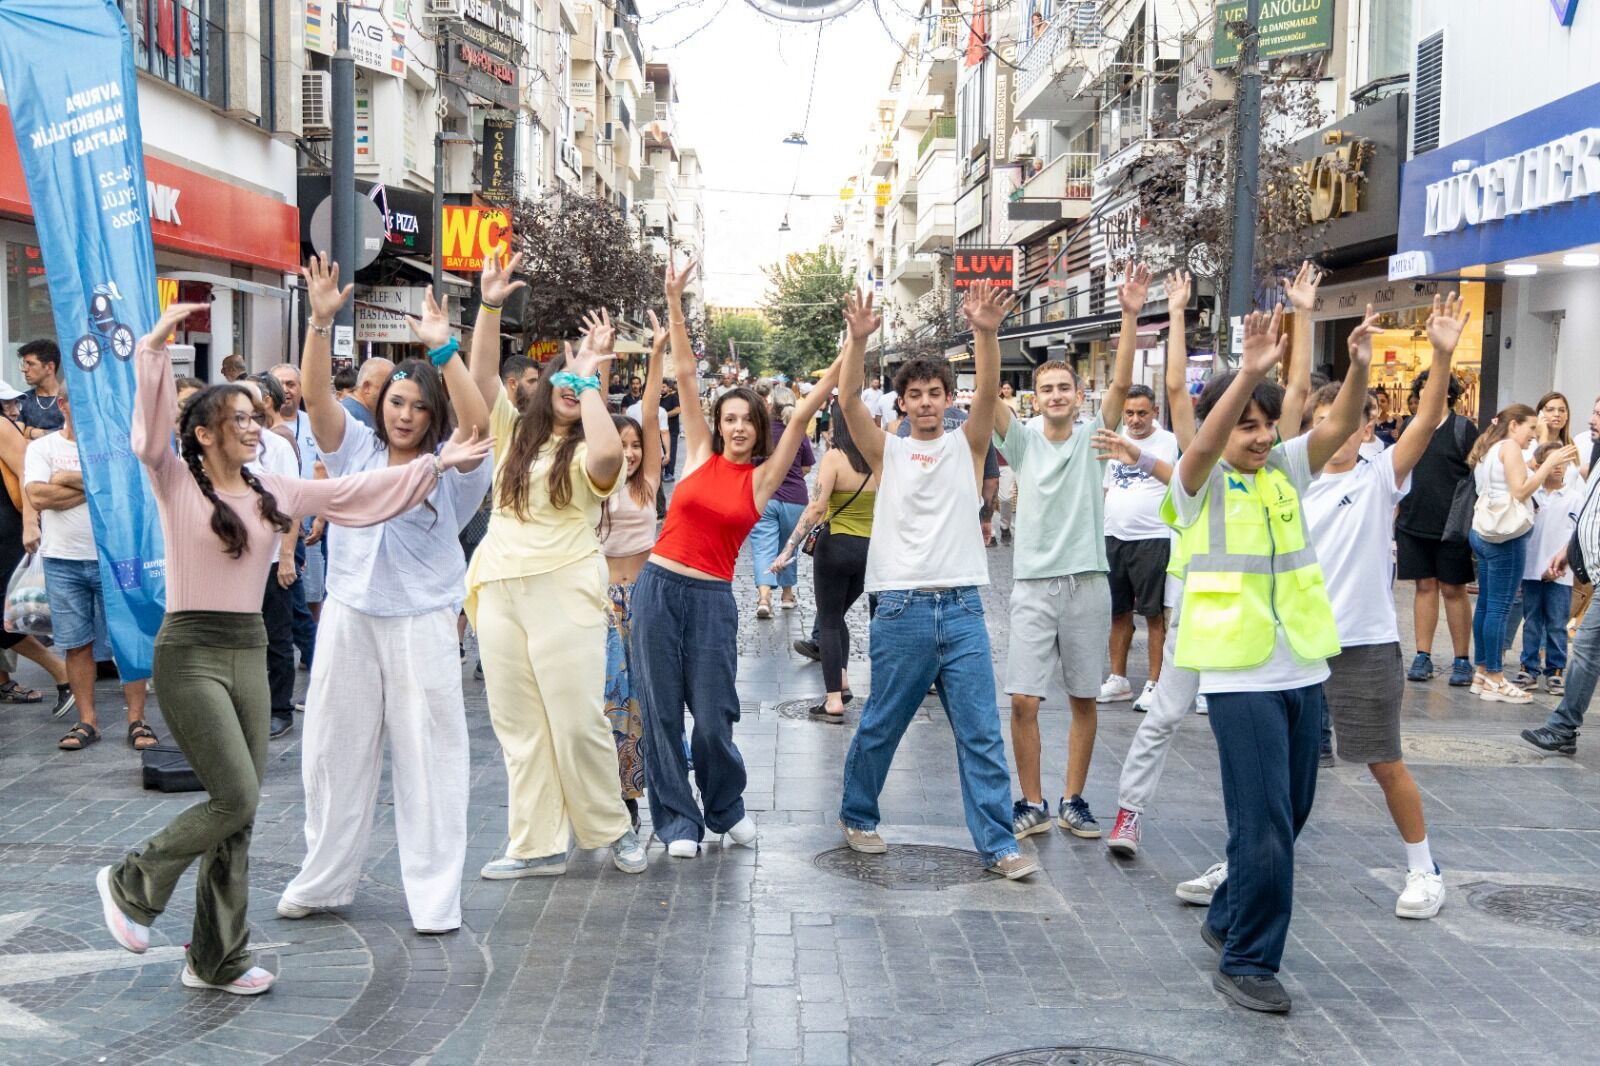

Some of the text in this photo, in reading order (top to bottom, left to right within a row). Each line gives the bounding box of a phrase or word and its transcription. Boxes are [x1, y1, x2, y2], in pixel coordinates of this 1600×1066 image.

[396, 212, 419, 233] PIZZA
[442, 208, 509, 258] WC
[1339, 292, 1357, 309] ATAKÖY
[1374, 286, 1395, 304] ATAKÖY
